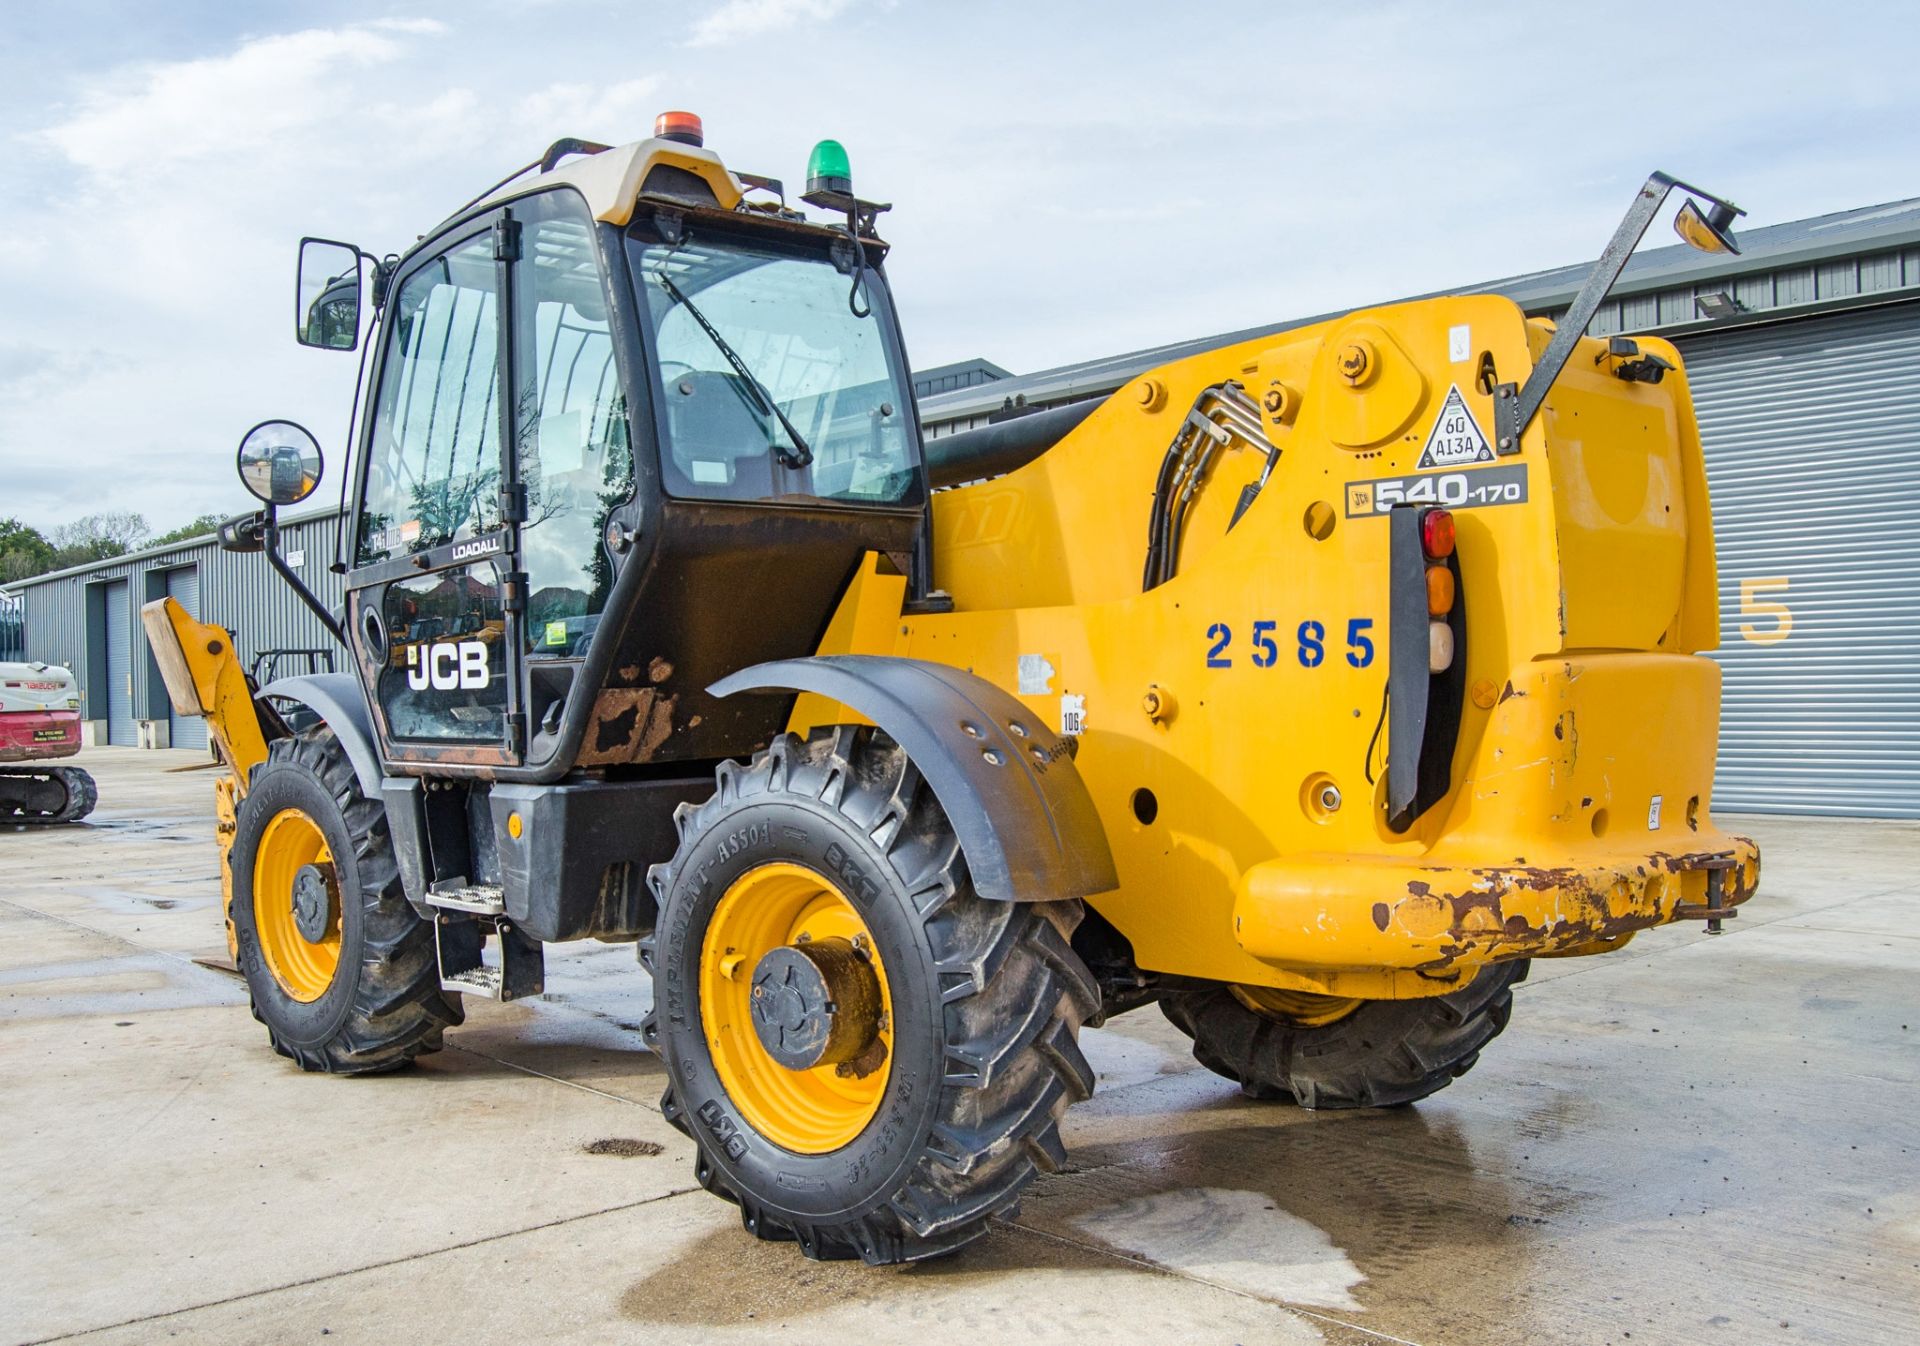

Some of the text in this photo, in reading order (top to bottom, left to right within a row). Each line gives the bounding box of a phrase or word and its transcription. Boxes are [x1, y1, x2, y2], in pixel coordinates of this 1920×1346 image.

[1352, 490, 1369, 508] JCB
[452, 537, 500, 560] LOADALL
[1740, 575, 1793, 646] 5
[407, 641, 490, 691] JCB
[1206, 618, 1375, 669] 2585
[1063, 712, 1079, 732] 106
[824, 842, 882, 907] BKT
[699, 1101, 749, 1161] BKT
